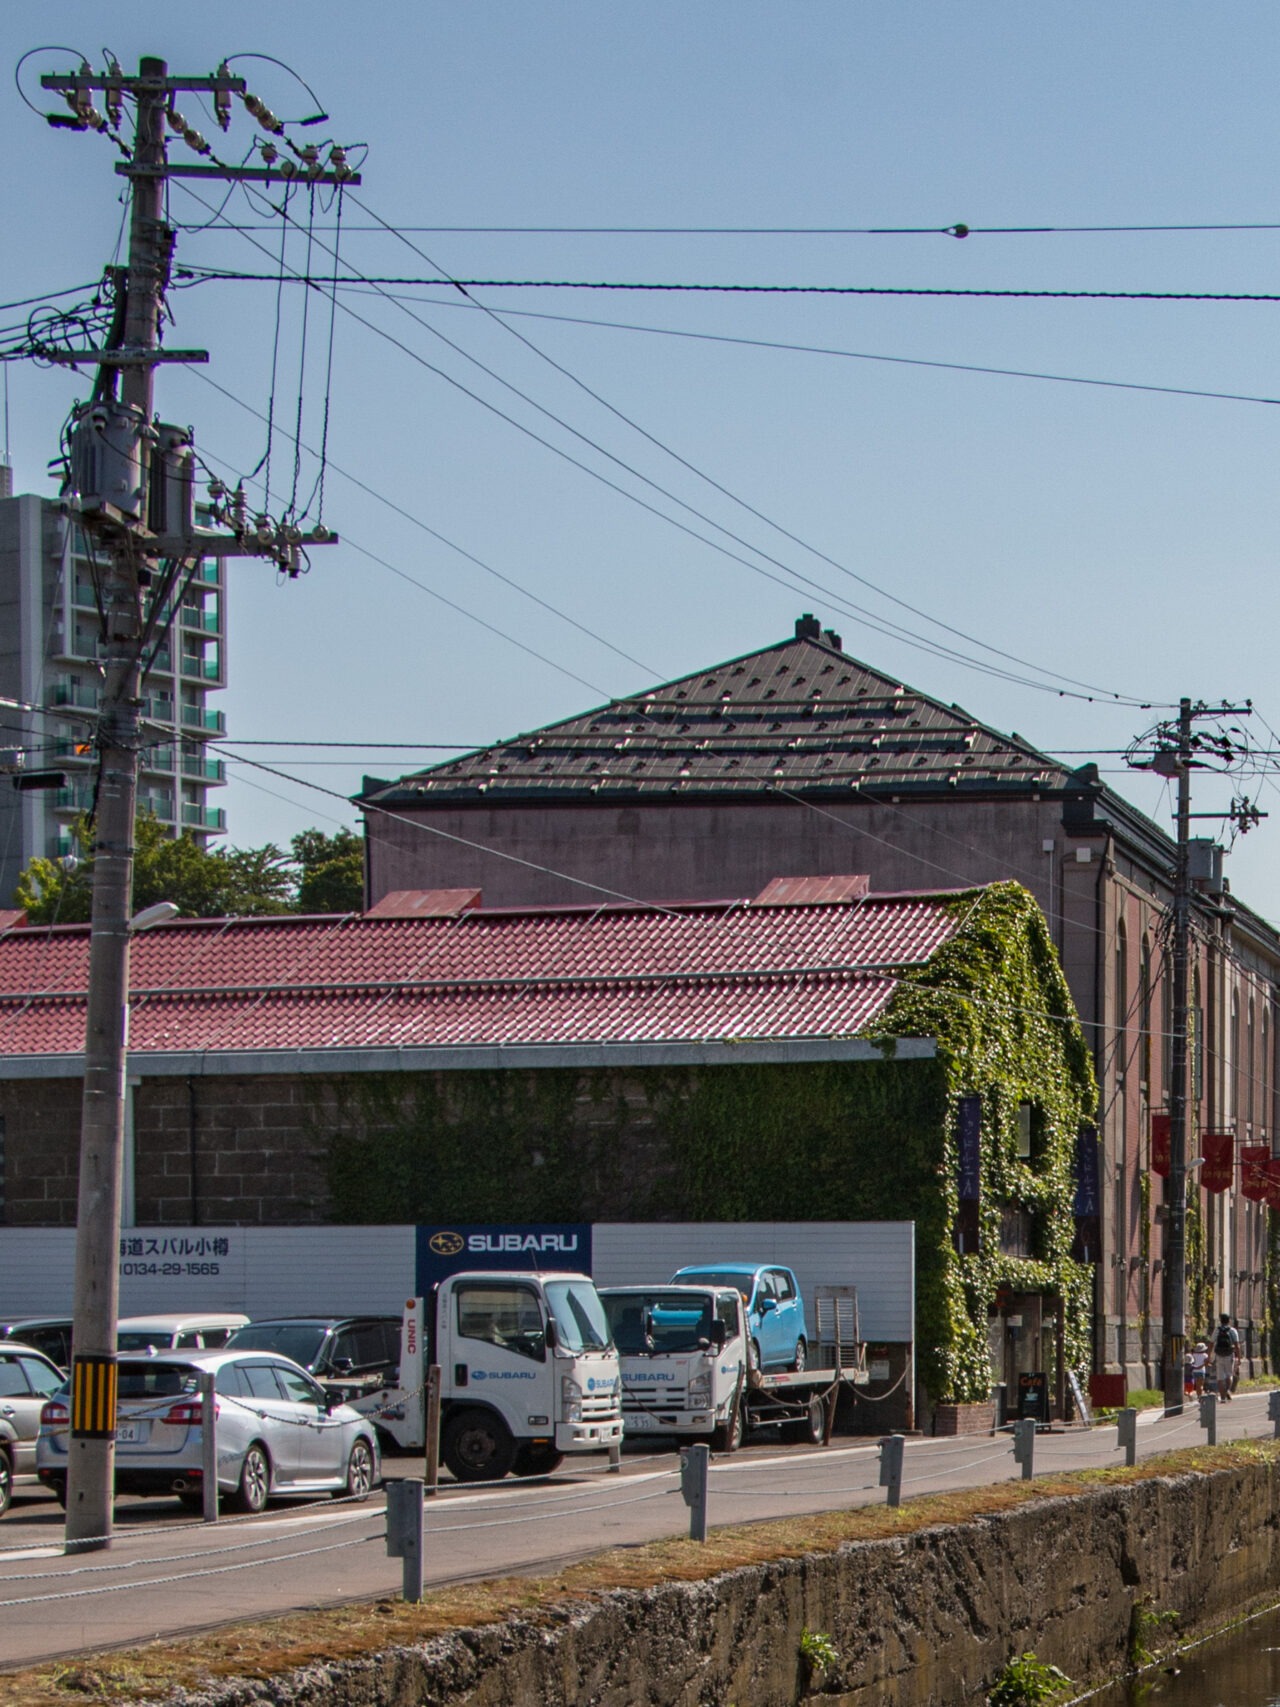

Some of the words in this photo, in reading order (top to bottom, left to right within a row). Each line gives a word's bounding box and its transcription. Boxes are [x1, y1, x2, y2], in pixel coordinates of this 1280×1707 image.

[468, 1234, 578, 1251] SUBARU
[407, 1319, 416, 1354] UNIC
[488, 1372, 536, 1380] SUBARU
[621, 1373, 675, 1381] SUBARU
